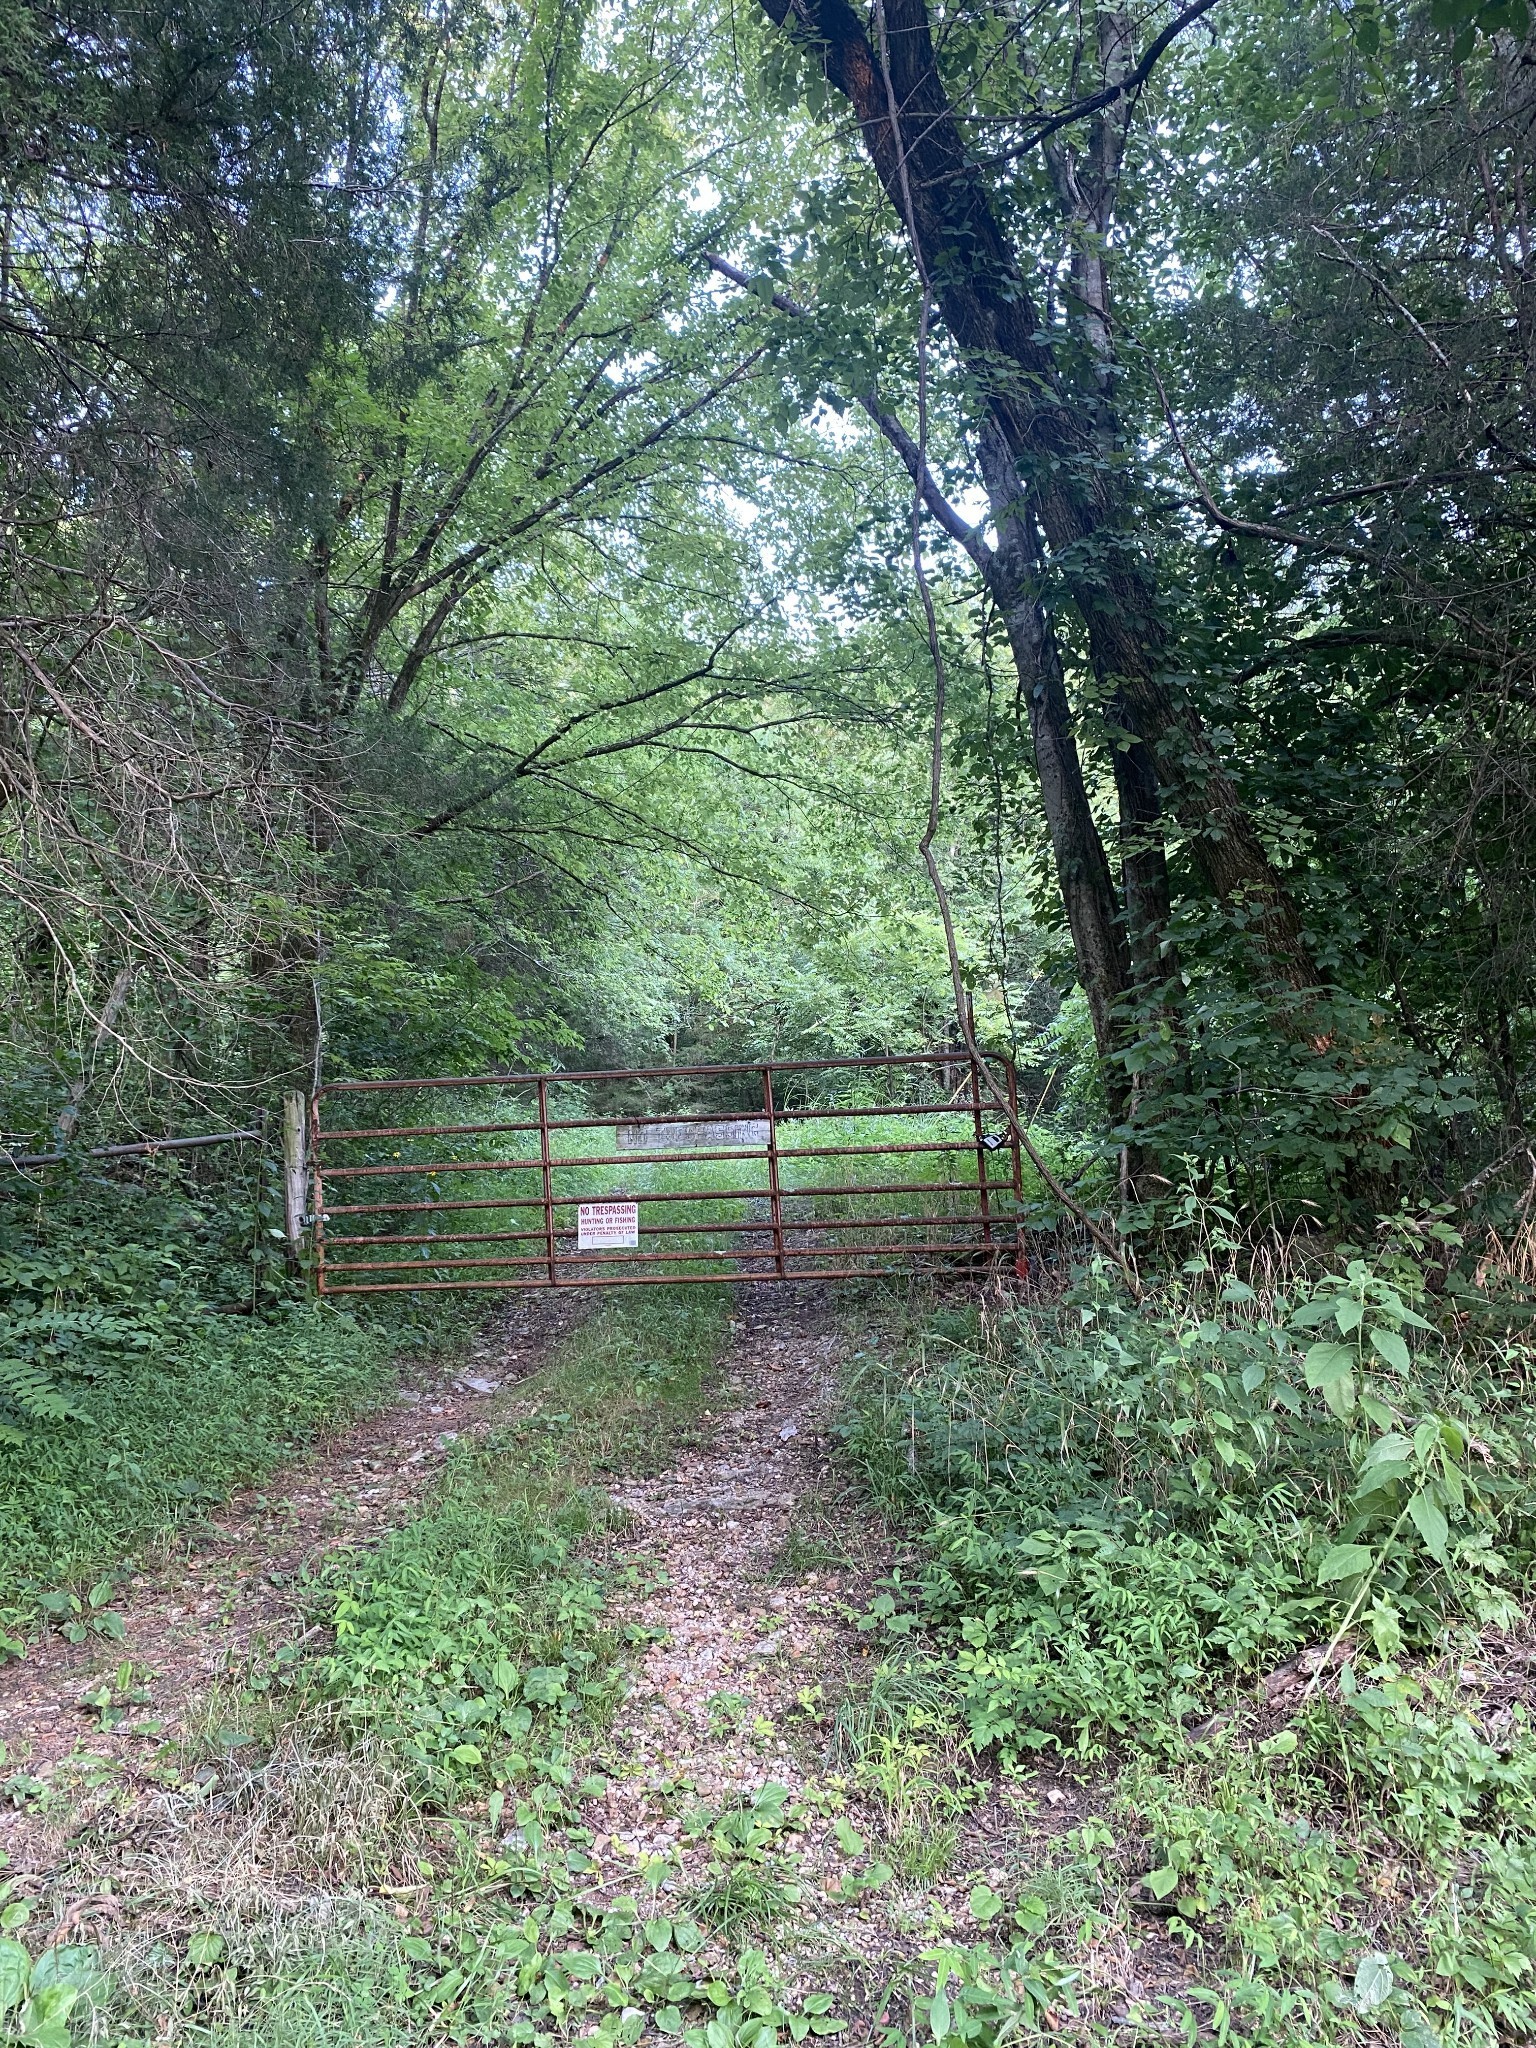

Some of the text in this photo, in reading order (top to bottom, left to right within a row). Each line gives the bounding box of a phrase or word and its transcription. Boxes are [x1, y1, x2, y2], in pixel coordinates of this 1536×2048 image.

[627, 1128, 648, 1145] NO
[580, 1204, 636, 1216] NO TRESPASSING
